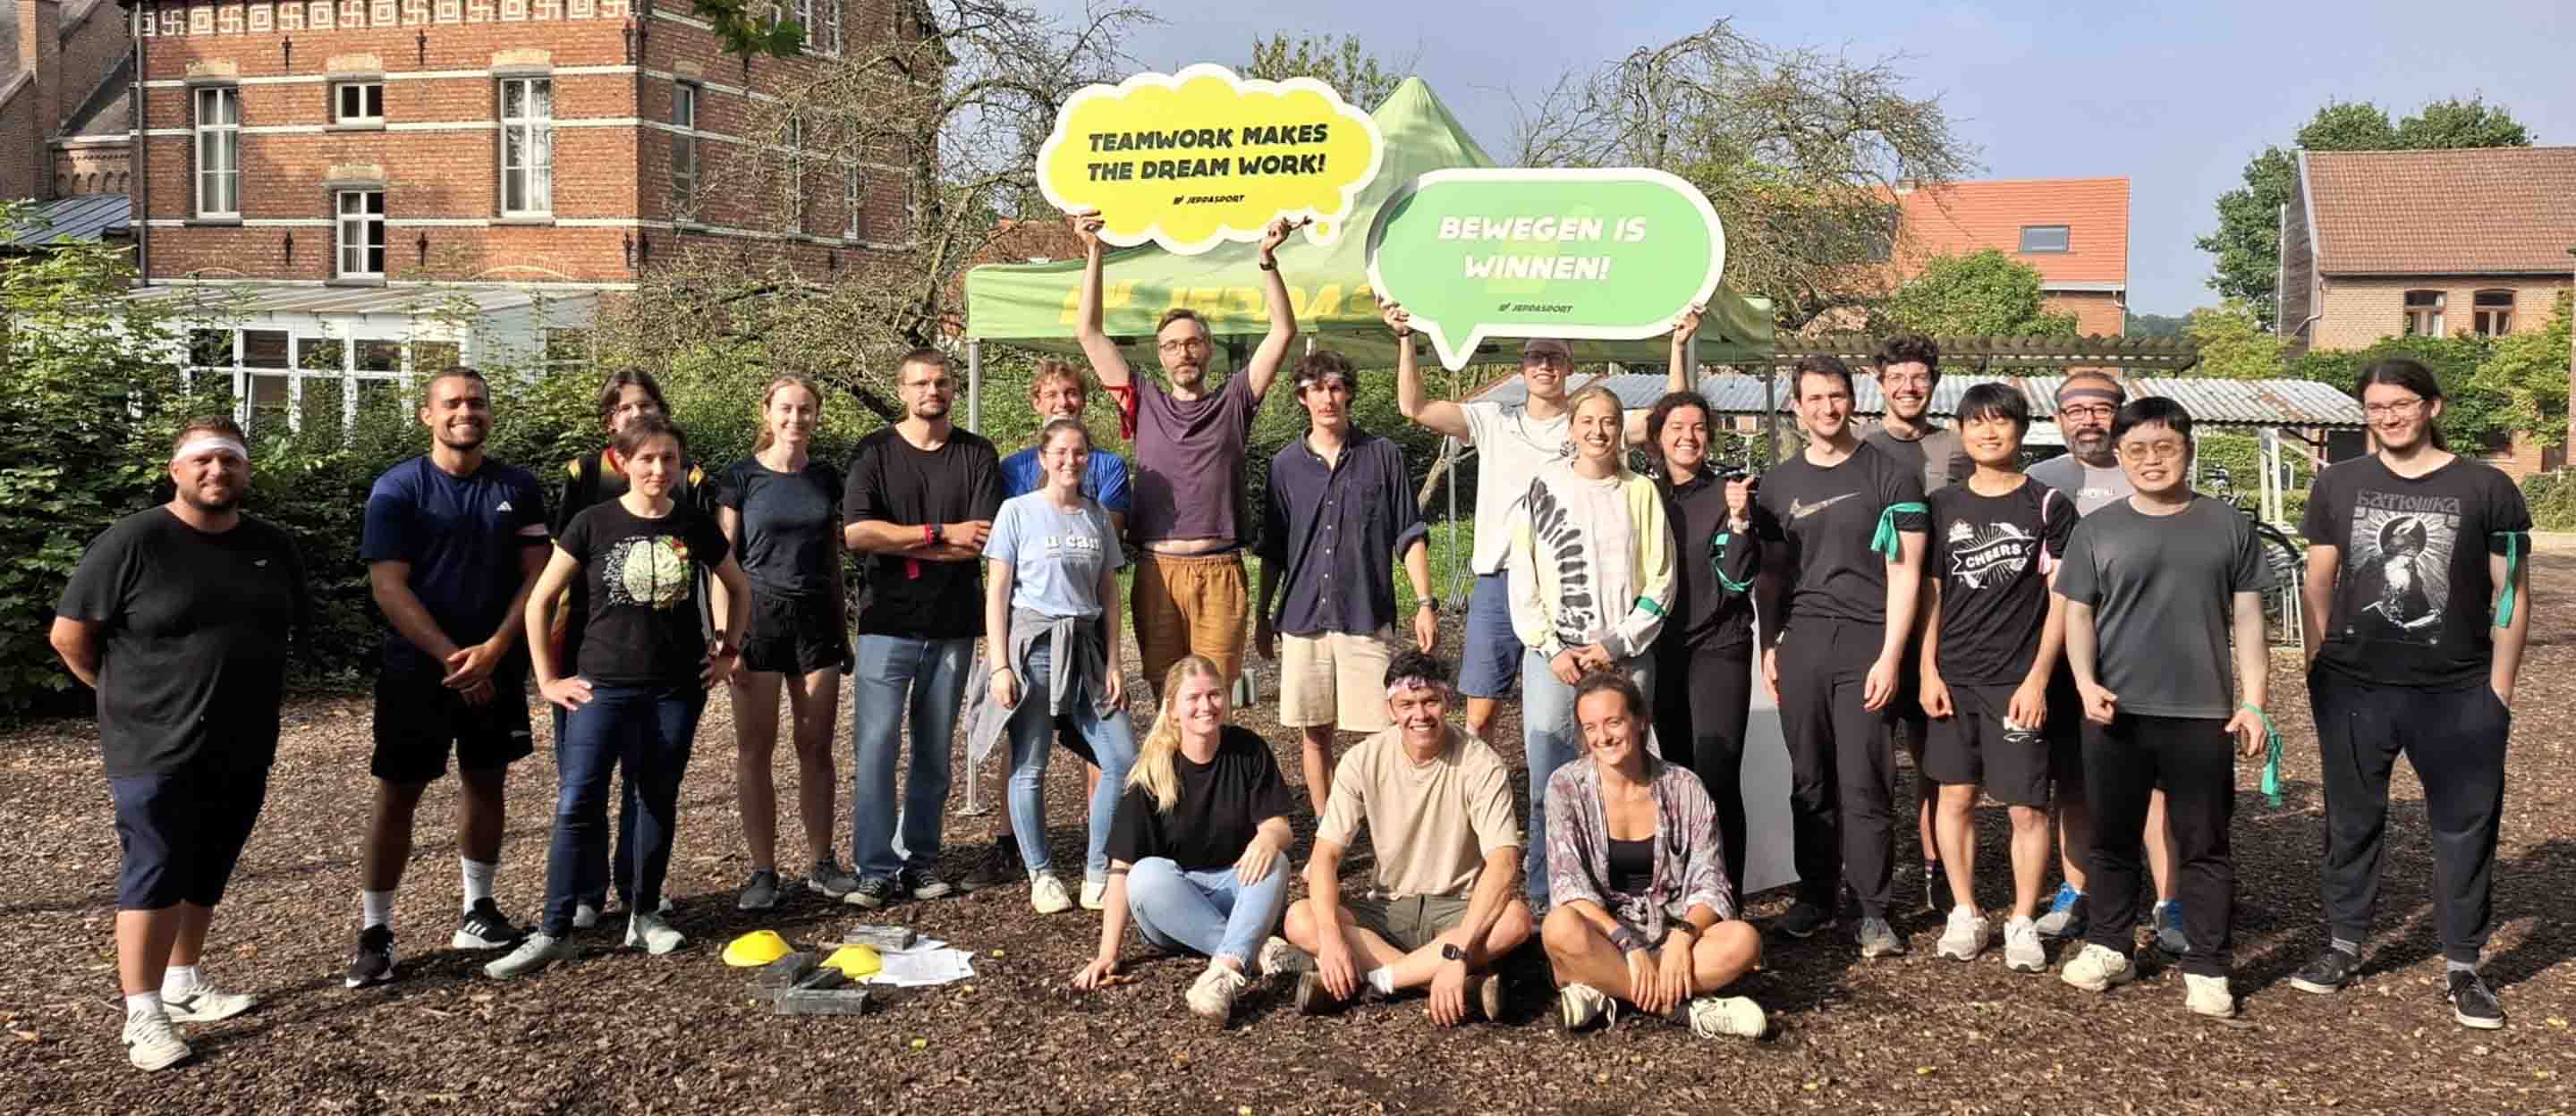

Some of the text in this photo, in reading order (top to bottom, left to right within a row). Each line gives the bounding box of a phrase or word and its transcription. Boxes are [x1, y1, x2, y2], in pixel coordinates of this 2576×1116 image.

[1089, 123, 1328, 152] TEAMWORK MAKES
[1088, 153, 1326, 181] THE DREAM WORK!
[1437, 216, 1647, 242] BEWEGEN IS
[1463, 254, 1612, 281] WINNEN!
[1965, 543, 2022, 568] CHEERS
